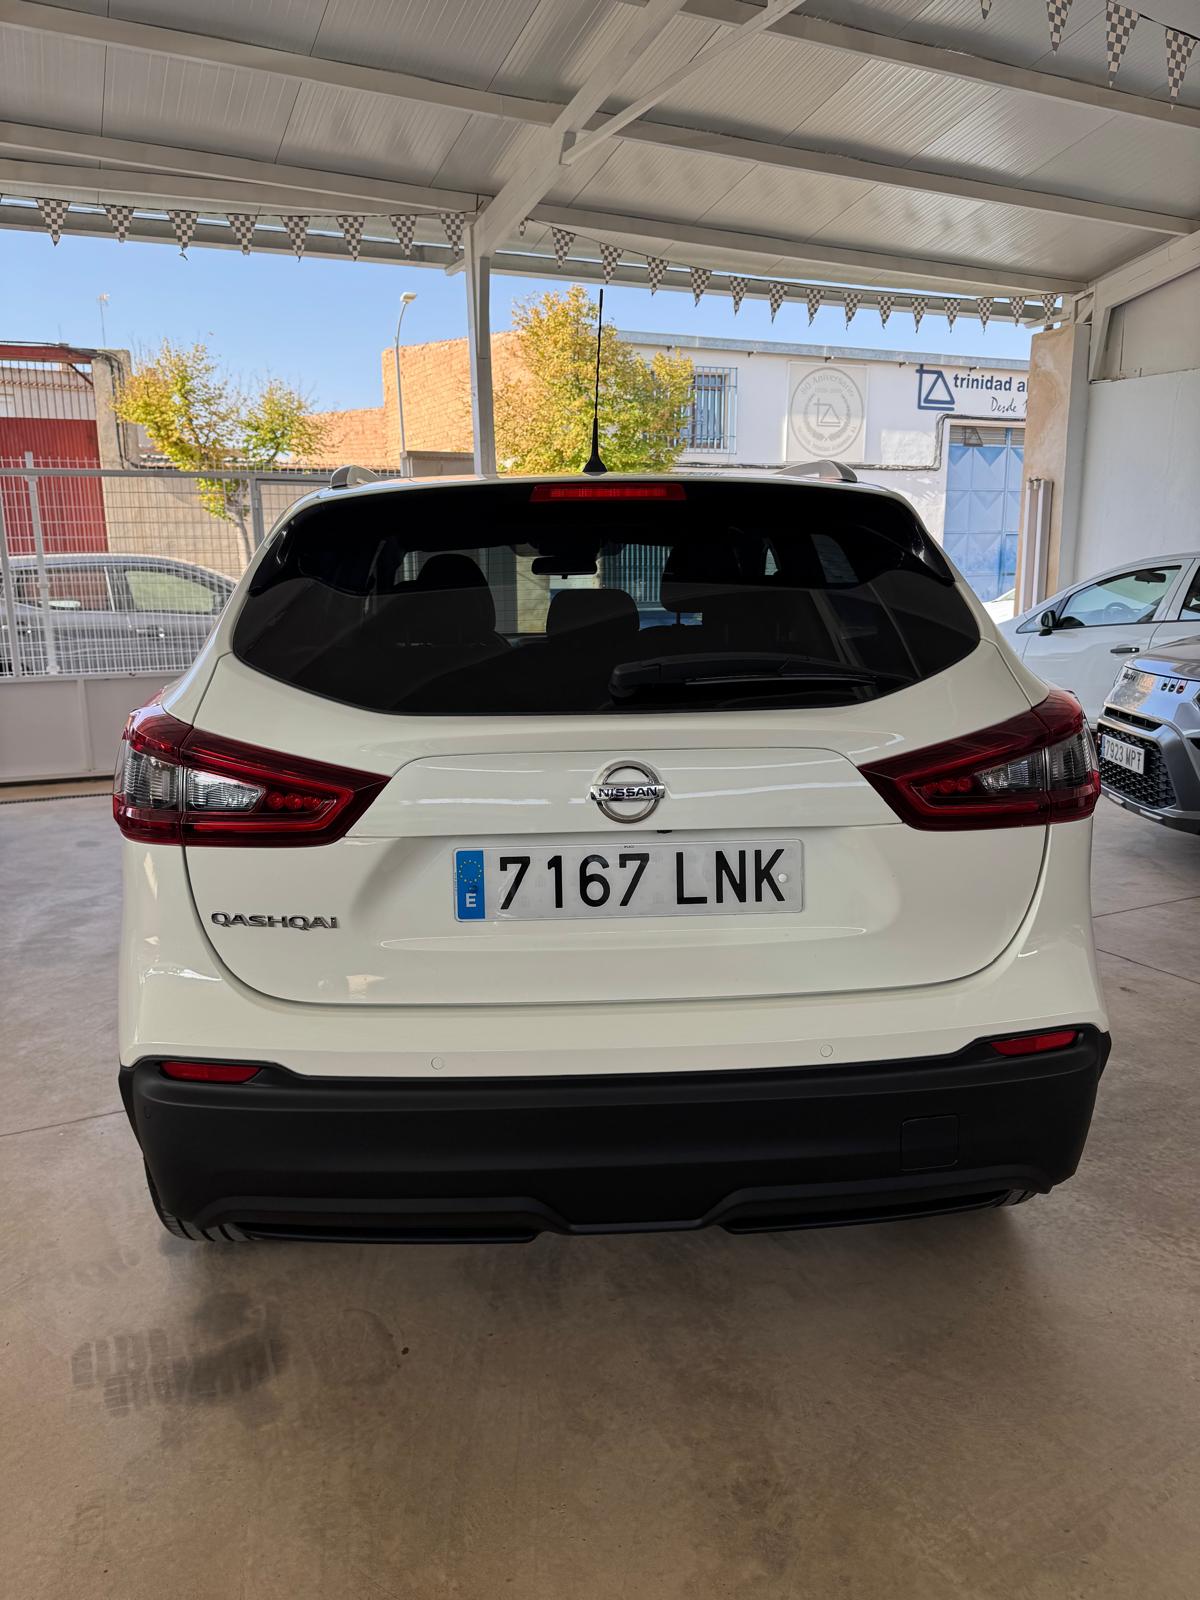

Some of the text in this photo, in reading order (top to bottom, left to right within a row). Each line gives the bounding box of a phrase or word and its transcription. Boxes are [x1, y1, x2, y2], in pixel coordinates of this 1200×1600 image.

[953, 373, 1012, 391] trinidad
[991, 396, 1017, 413] Desde
[1105, 740, 1124, 763] 7923
[598, 787, 658, 798] NISSAN
[499, 849, 785, 910] 7167 LNK
[465, 893, 477, 908] E
[211, 912, 339, 931] QASHQAI
